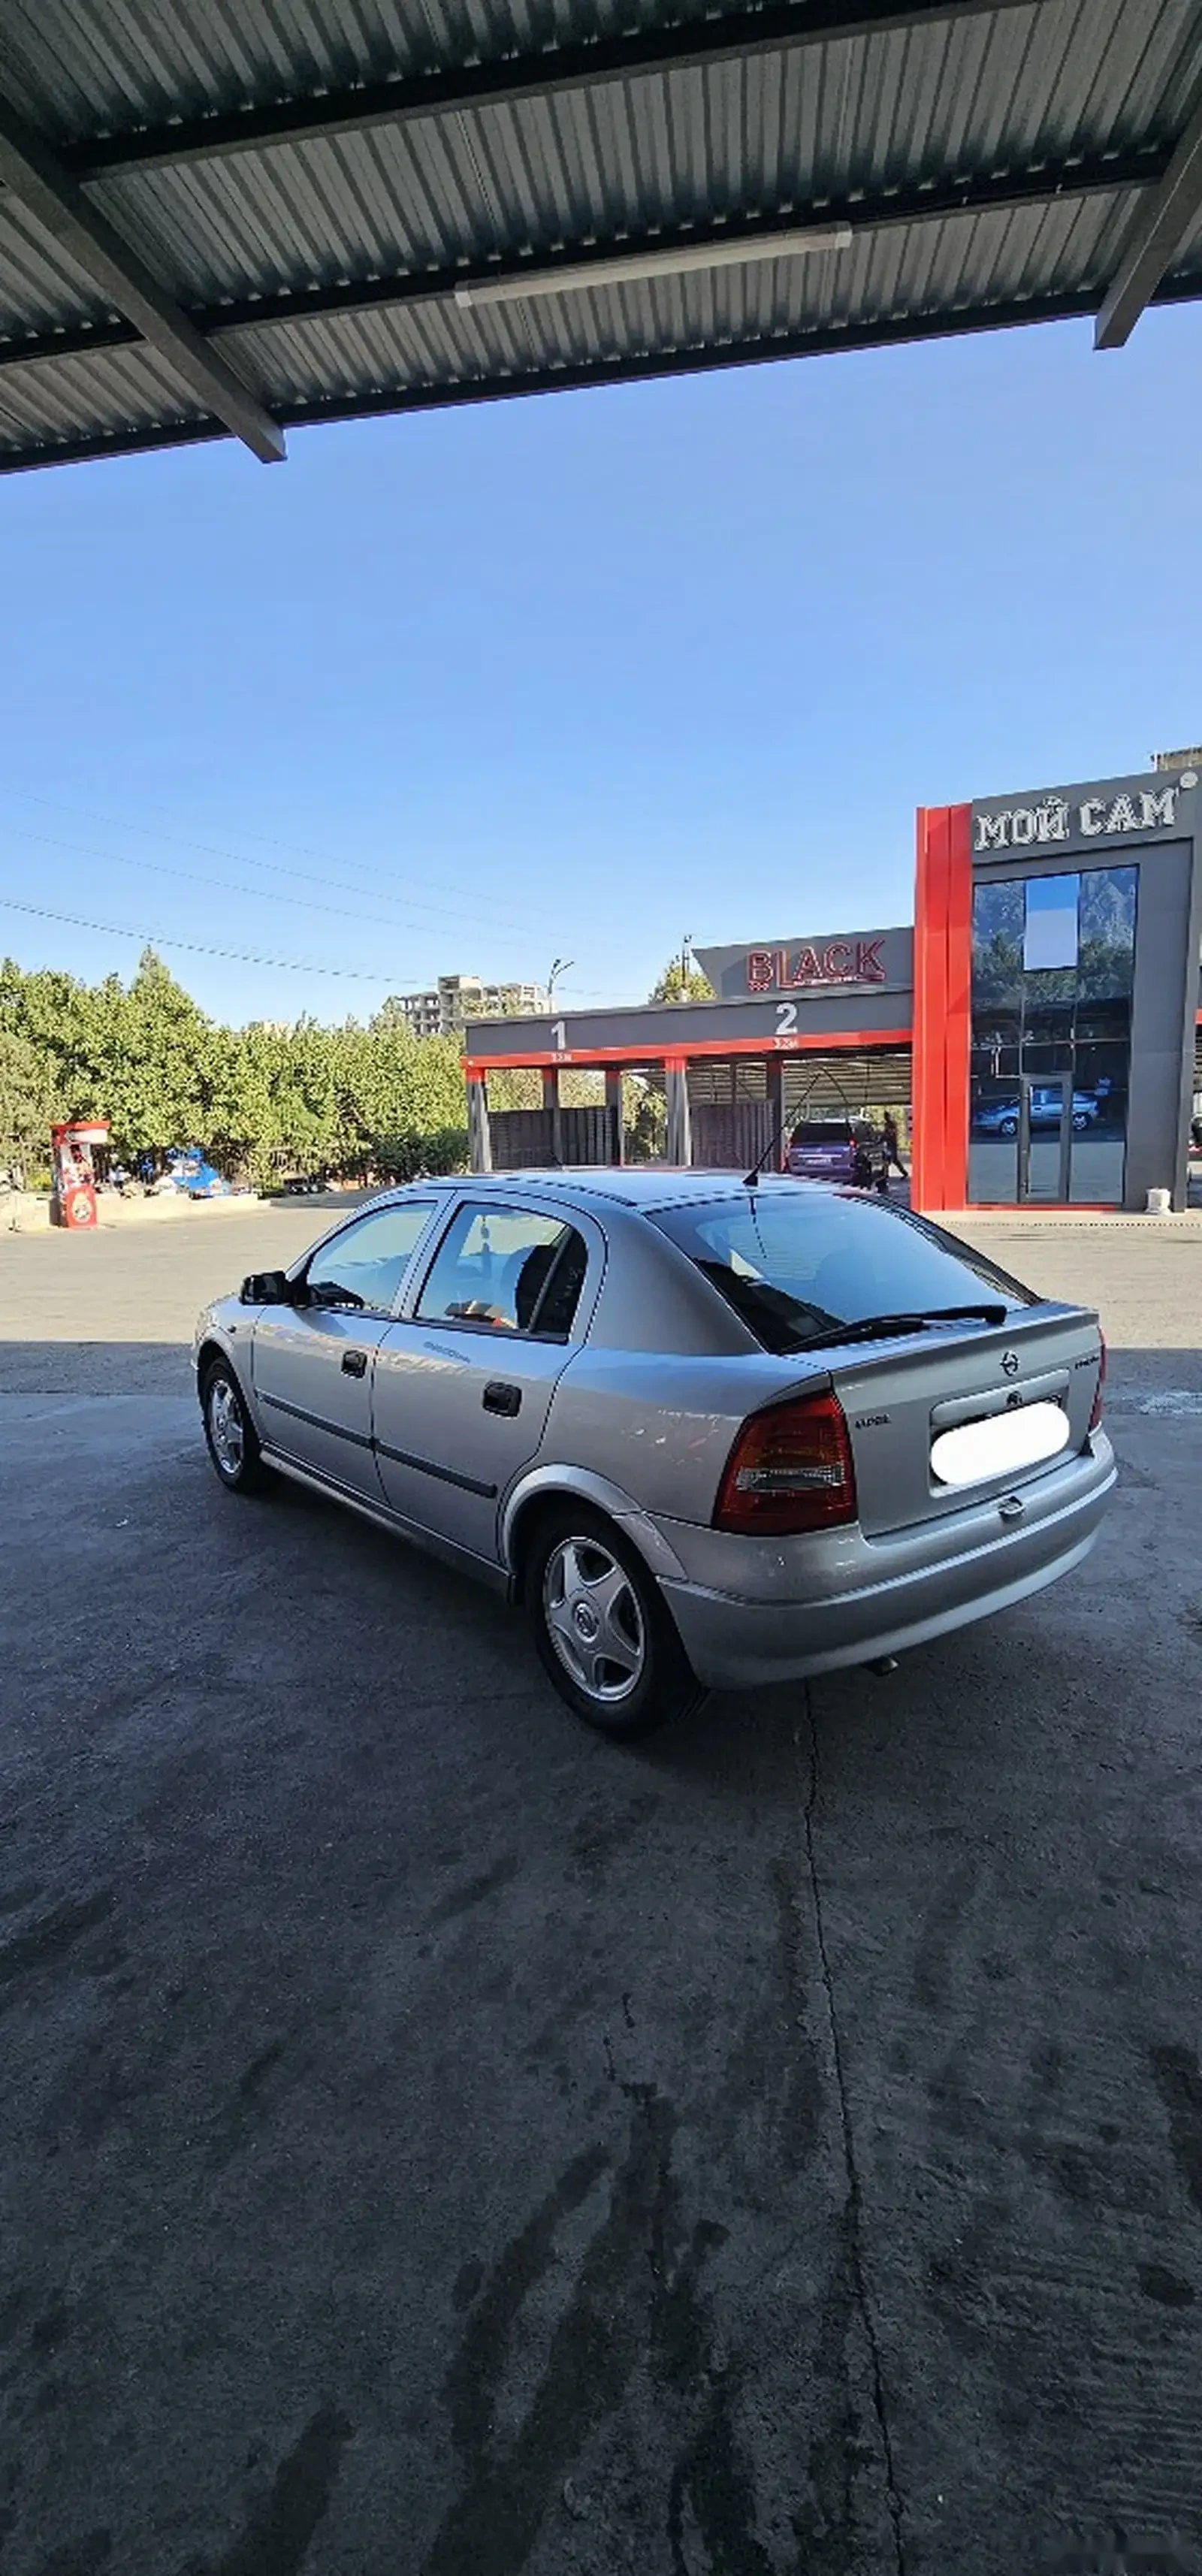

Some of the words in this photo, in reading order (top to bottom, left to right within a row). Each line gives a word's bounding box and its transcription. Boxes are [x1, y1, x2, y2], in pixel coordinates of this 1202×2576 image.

[974, 795, 1071, 851] МОЙ
[1080, 787, 1177, 836] САМ
[747, 939, 886, 989] BLACK
[551, 1020, 566, 1050] 1
[775, 1002, 798, 1035] 2
